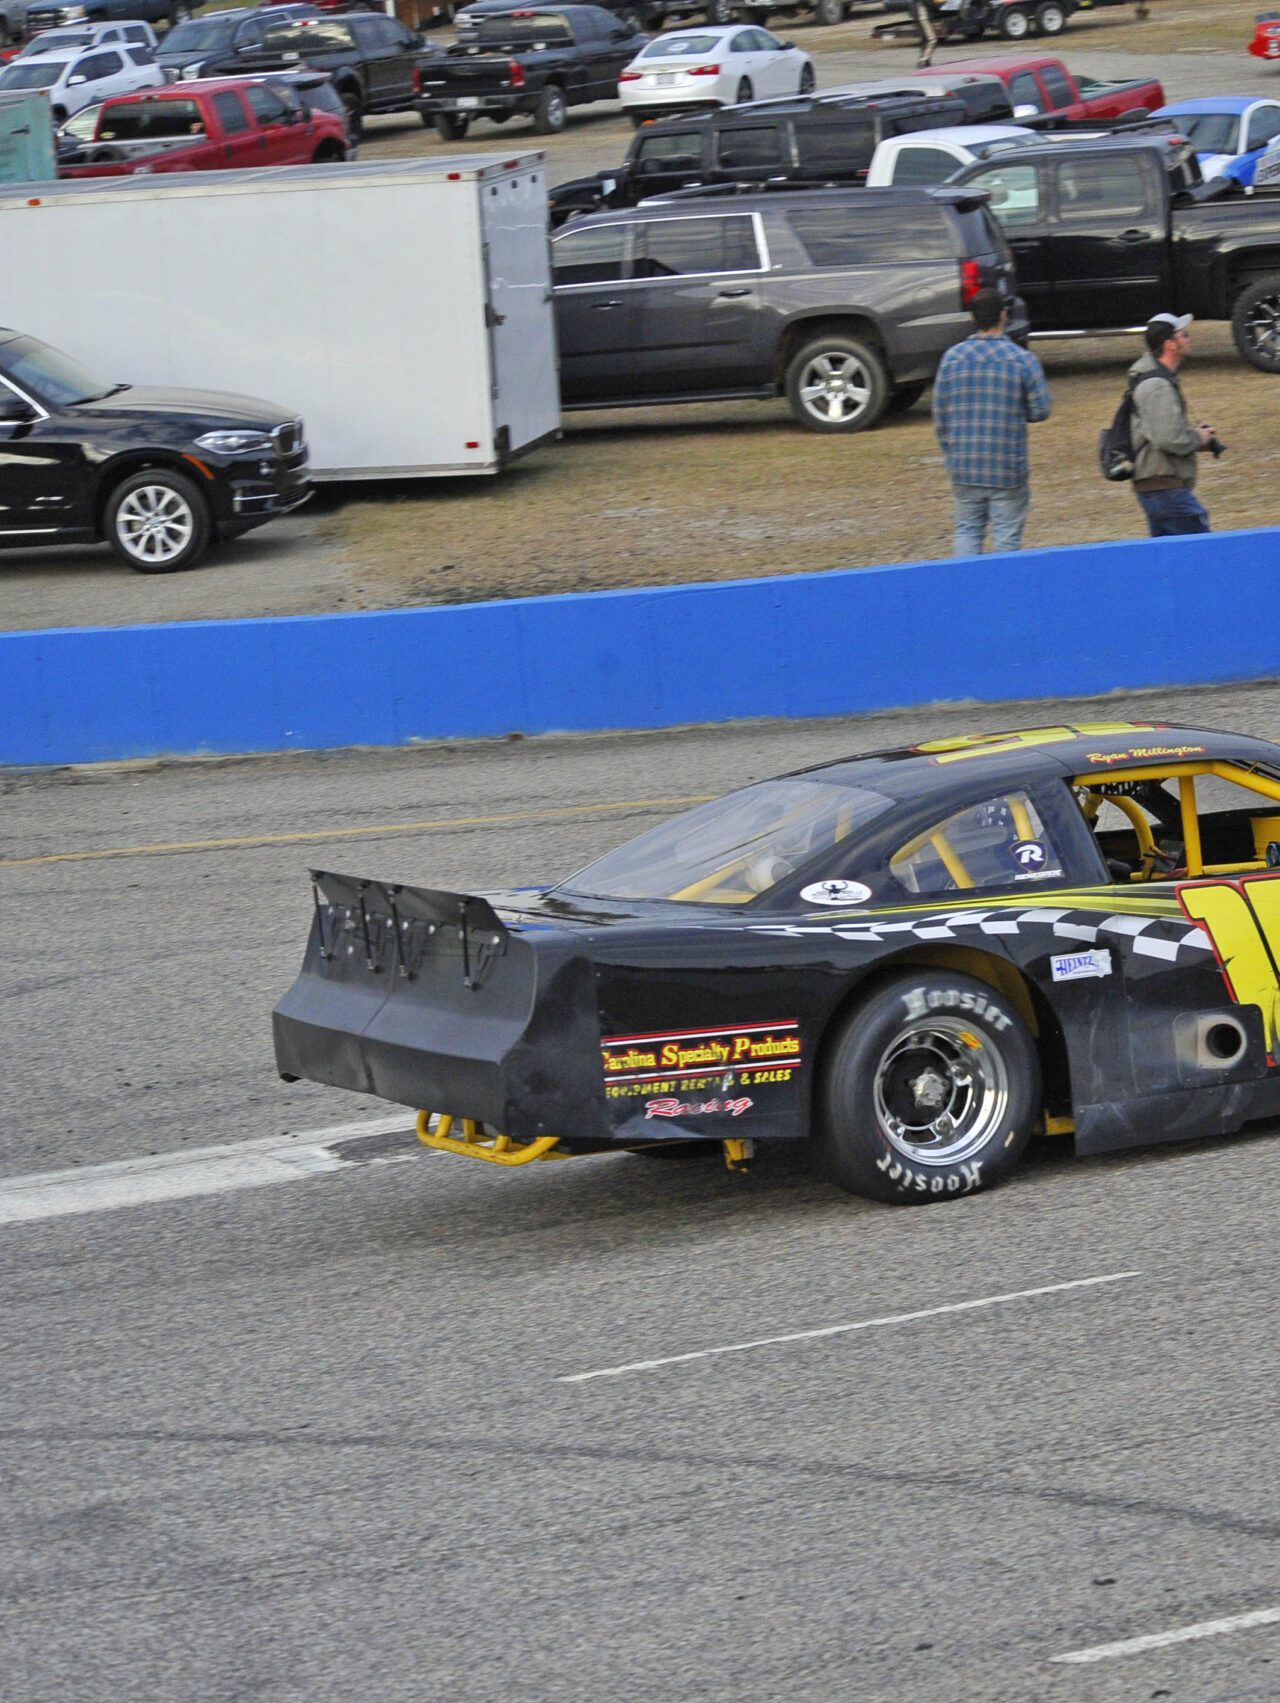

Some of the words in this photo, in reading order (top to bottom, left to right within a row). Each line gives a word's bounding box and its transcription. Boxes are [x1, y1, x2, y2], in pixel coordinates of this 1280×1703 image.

[1086, 753, 1131, 764] Ryan
[1128, 746, 1206, 759] Millington
[660, 1041, 731, 1068] Specialty
[731, 1036, 800, 1059] Products
[740, 1072, 751, 1085] &
[753, 1069, 792, 1084] SALES
[645, 1097, 754, 1119] Racing
